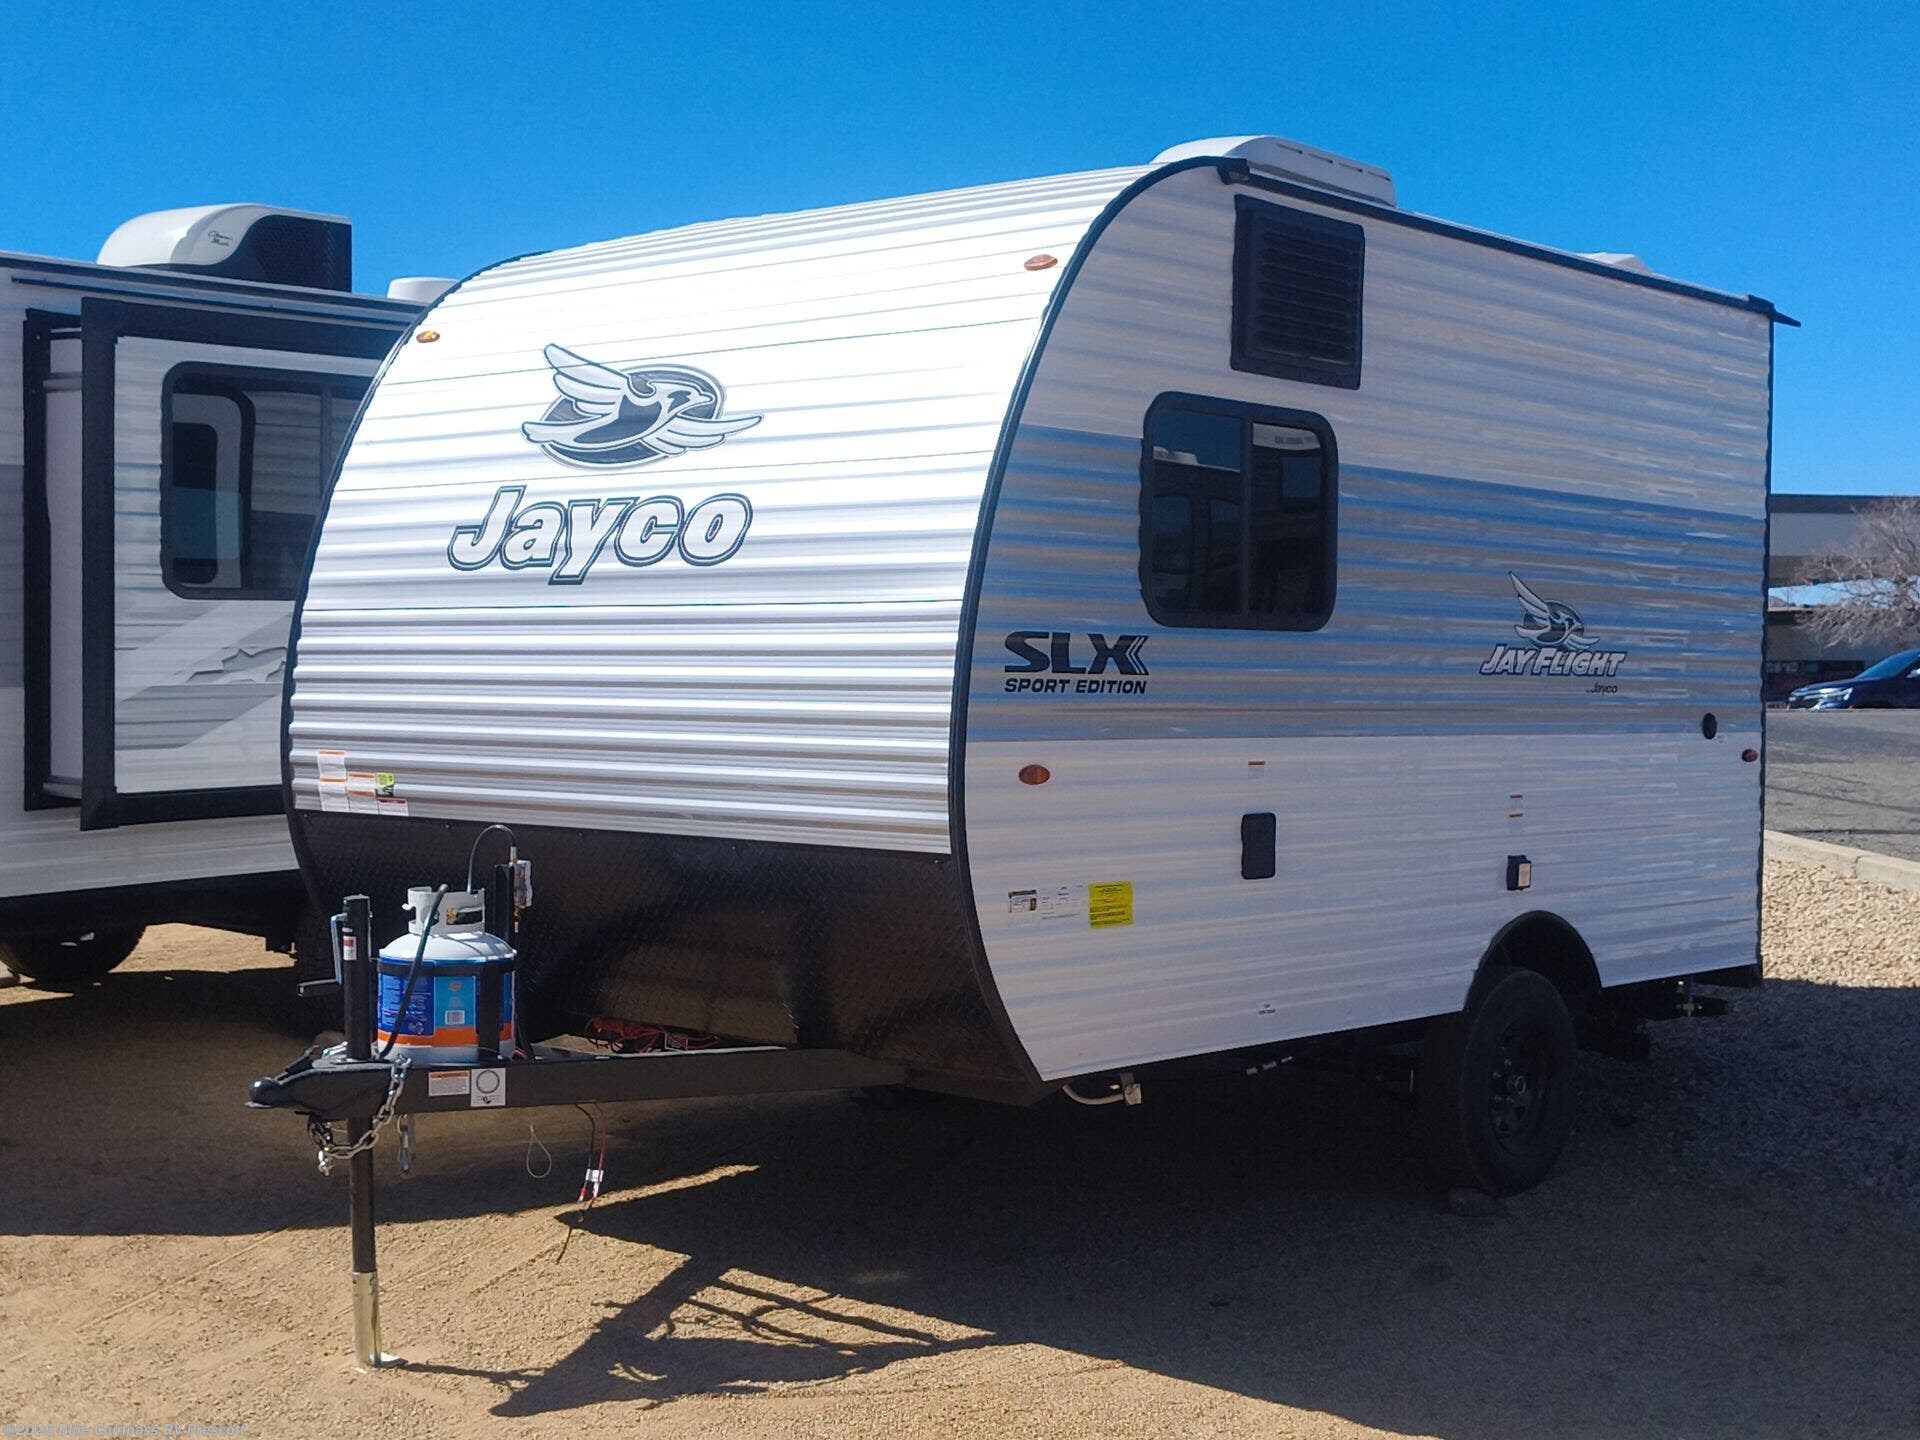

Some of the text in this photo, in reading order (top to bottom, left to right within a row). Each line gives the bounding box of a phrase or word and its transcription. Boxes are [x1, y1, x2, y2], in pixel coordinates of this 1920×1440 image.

[447, 484, 754, 585] Jayco
[1004, 630, 1149, 675] SLX
[1004, 677, 1147, 694] SPORT EDITION
